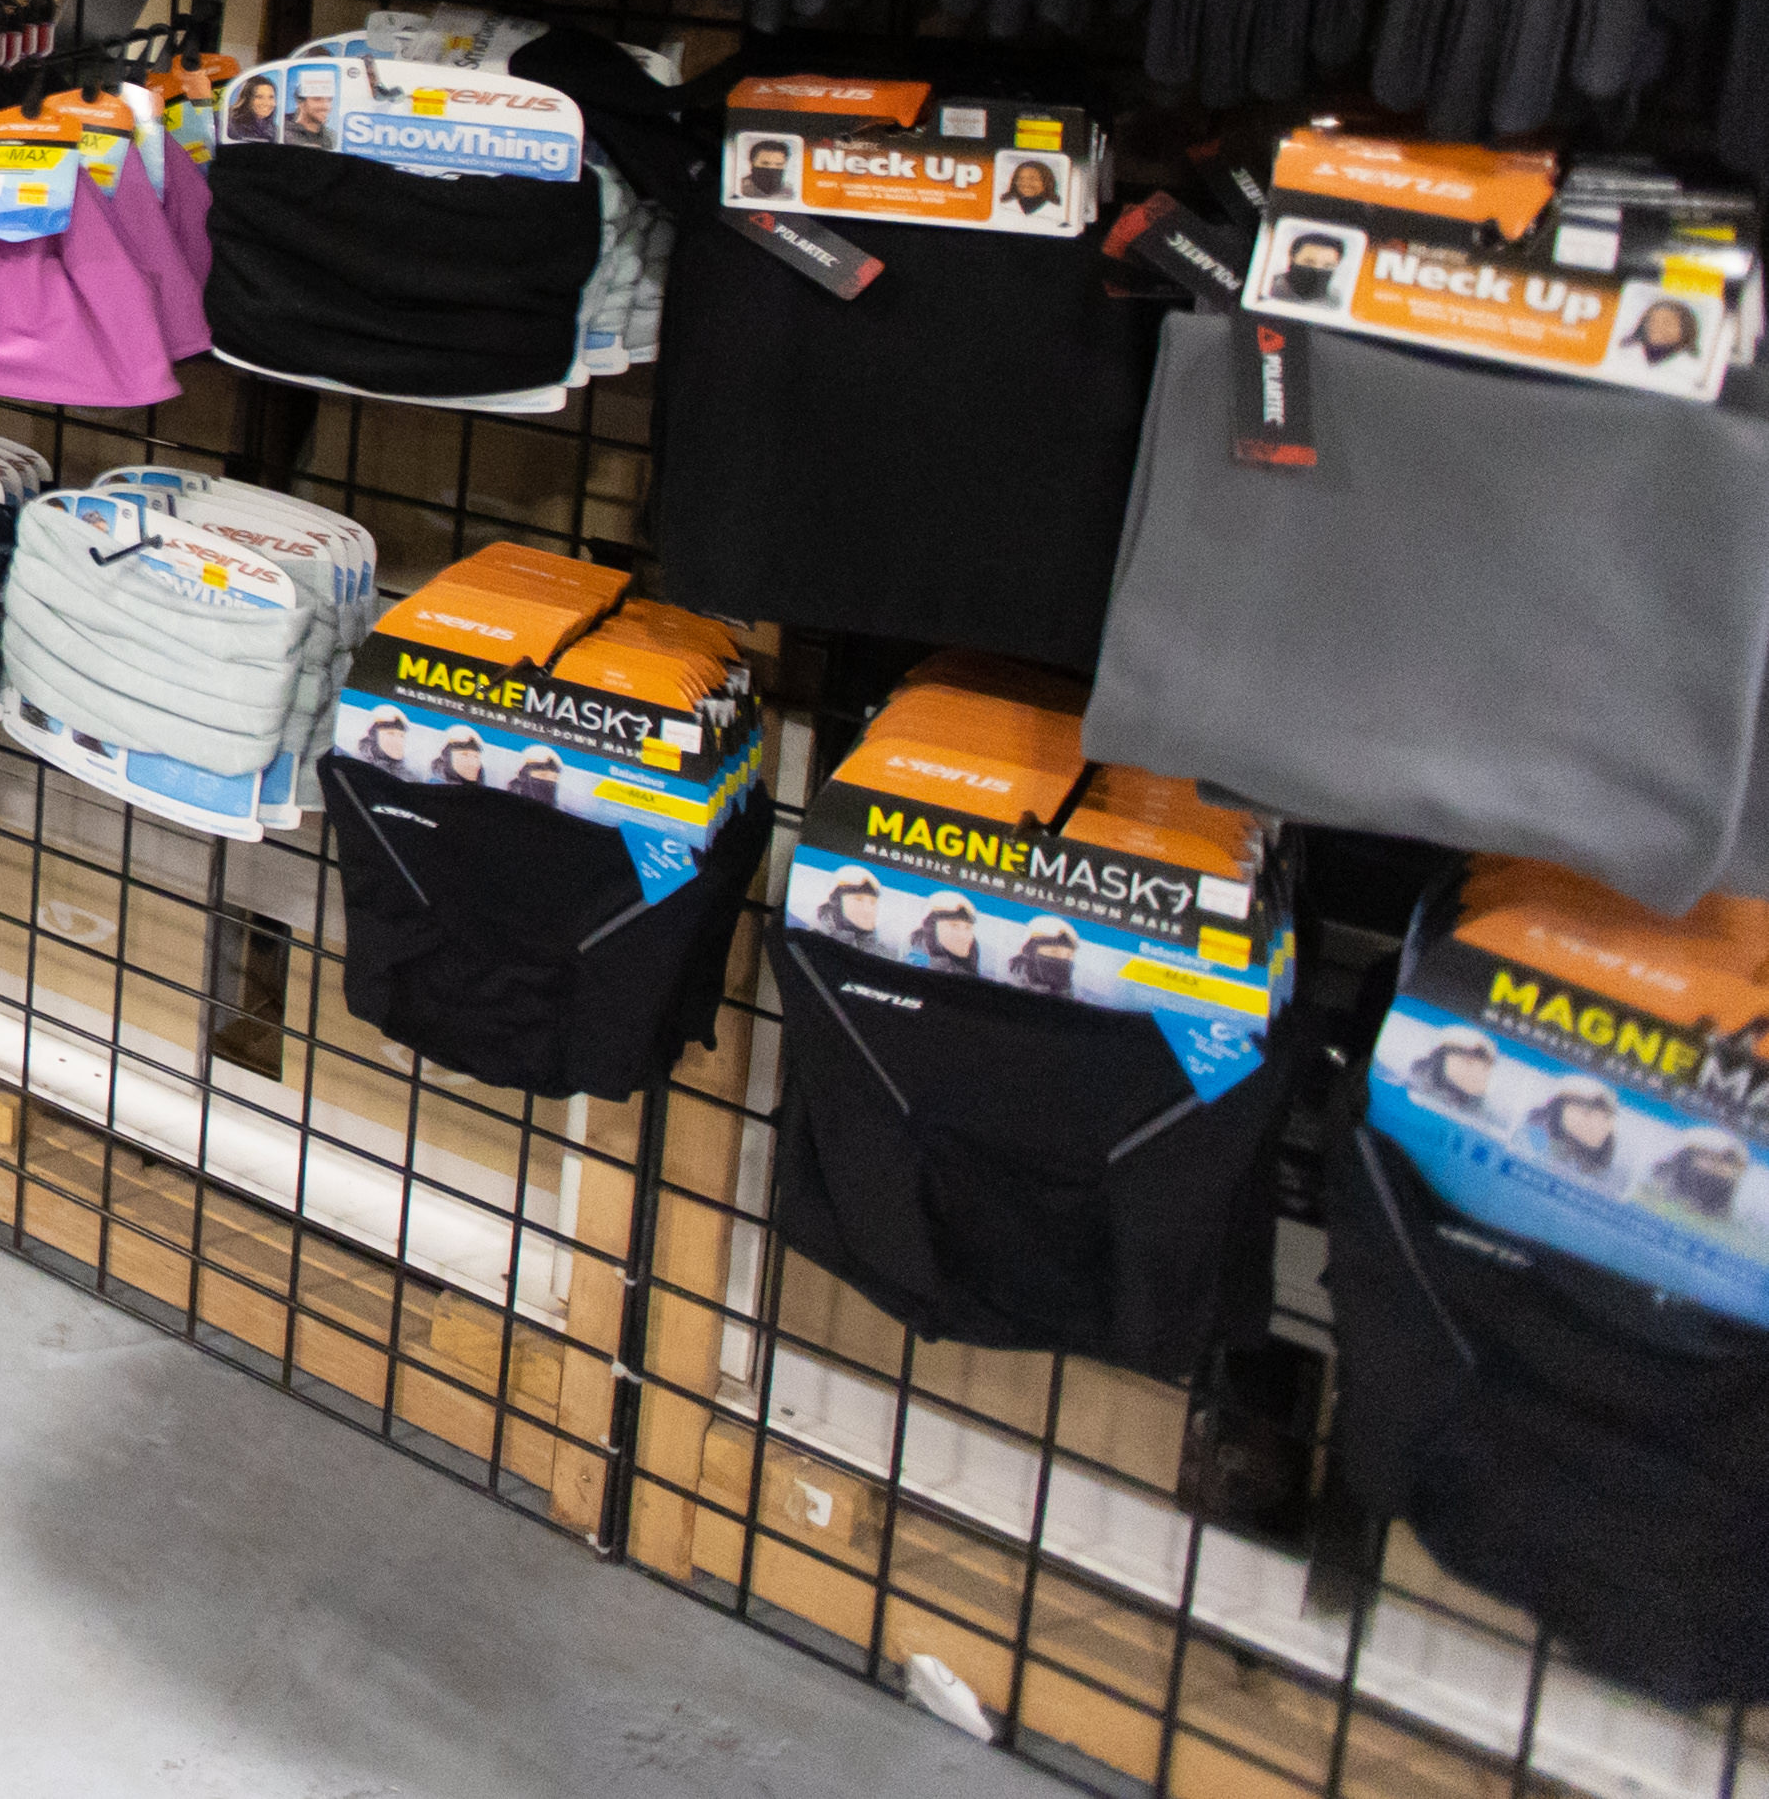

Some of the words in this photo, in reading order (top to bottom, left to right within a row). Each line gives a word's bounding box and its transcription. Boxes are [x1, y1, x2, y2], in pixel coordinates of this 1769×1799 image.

[344, 114, 570, 173] SnowThing
[812, 147, 917, 179] Neck
[923, 155, 983, 189] Up
[774, 221, 840, 270] POLARTEC
[1165, 231, 1243, 292] POLARTEC
[1373, 248, 1513, 304] Neck
[1522, 277, 1603, 325] Up
[1262, 352, 1286, 429] POLARTEC
[416, 609, 519, 642] seirus
[395, 685, 467, 714] MAGNETIC
[470, 702, 509, 725] SEAM
[512, 713, 600, 749] PULL-DOWN
[397, 652, 631, 742] MAGNEMASK
[885, 755, 1014, 794] seirus
[866, 804, 1161, 911] MAGNEMASK
[863, 843, 952, 876] MAGNETIC
[959, 864, 1006, 888] SEAM
[1014, 881, 1123, 921] PULL-DOWN
[1130, 910, 1183, 937] MASK
[840, 980, 924, 1010] seirus
[1489, 970, 1769, 1101] MAGNEM
